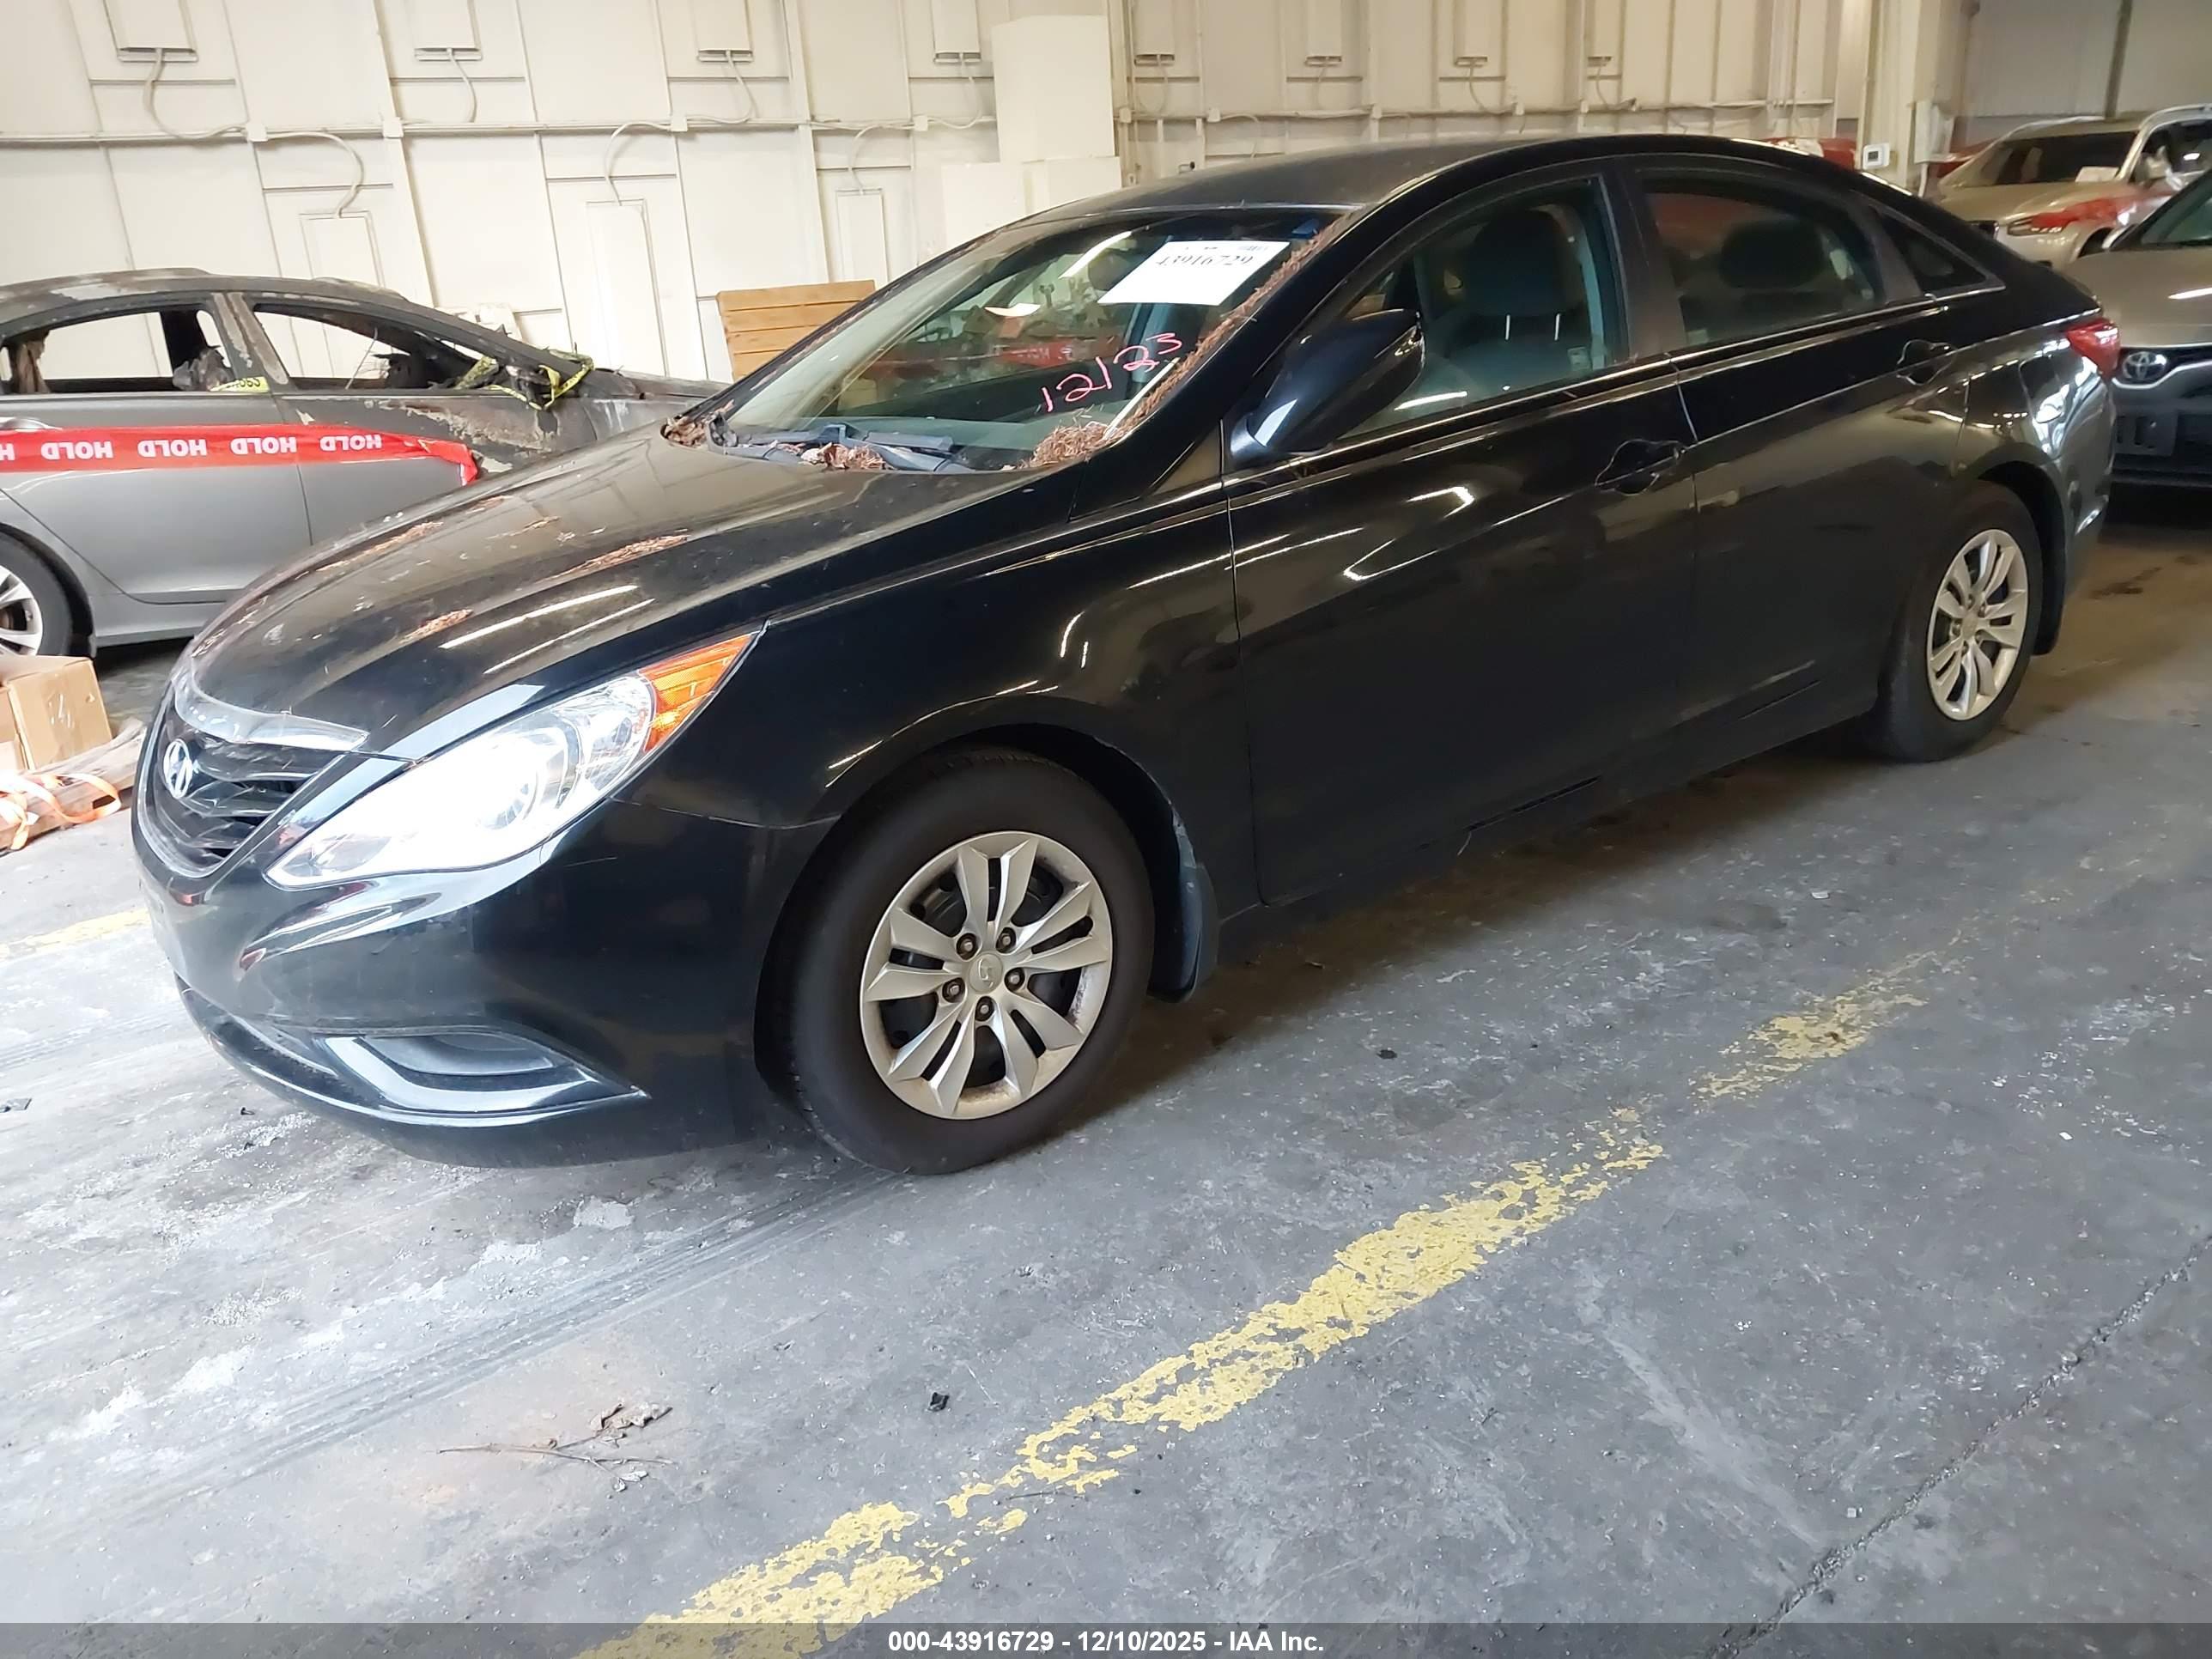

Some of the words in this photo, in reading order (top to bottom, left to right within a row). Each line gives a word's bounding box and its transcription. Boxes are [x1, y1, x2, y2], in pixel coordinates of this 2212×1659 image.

[40, 441, 114, 460] HOLD
[137, 439, 208, 459] HOLD
[230, 436, 297, 455] HOLD
[319, 434, 382, 452] HOLD
